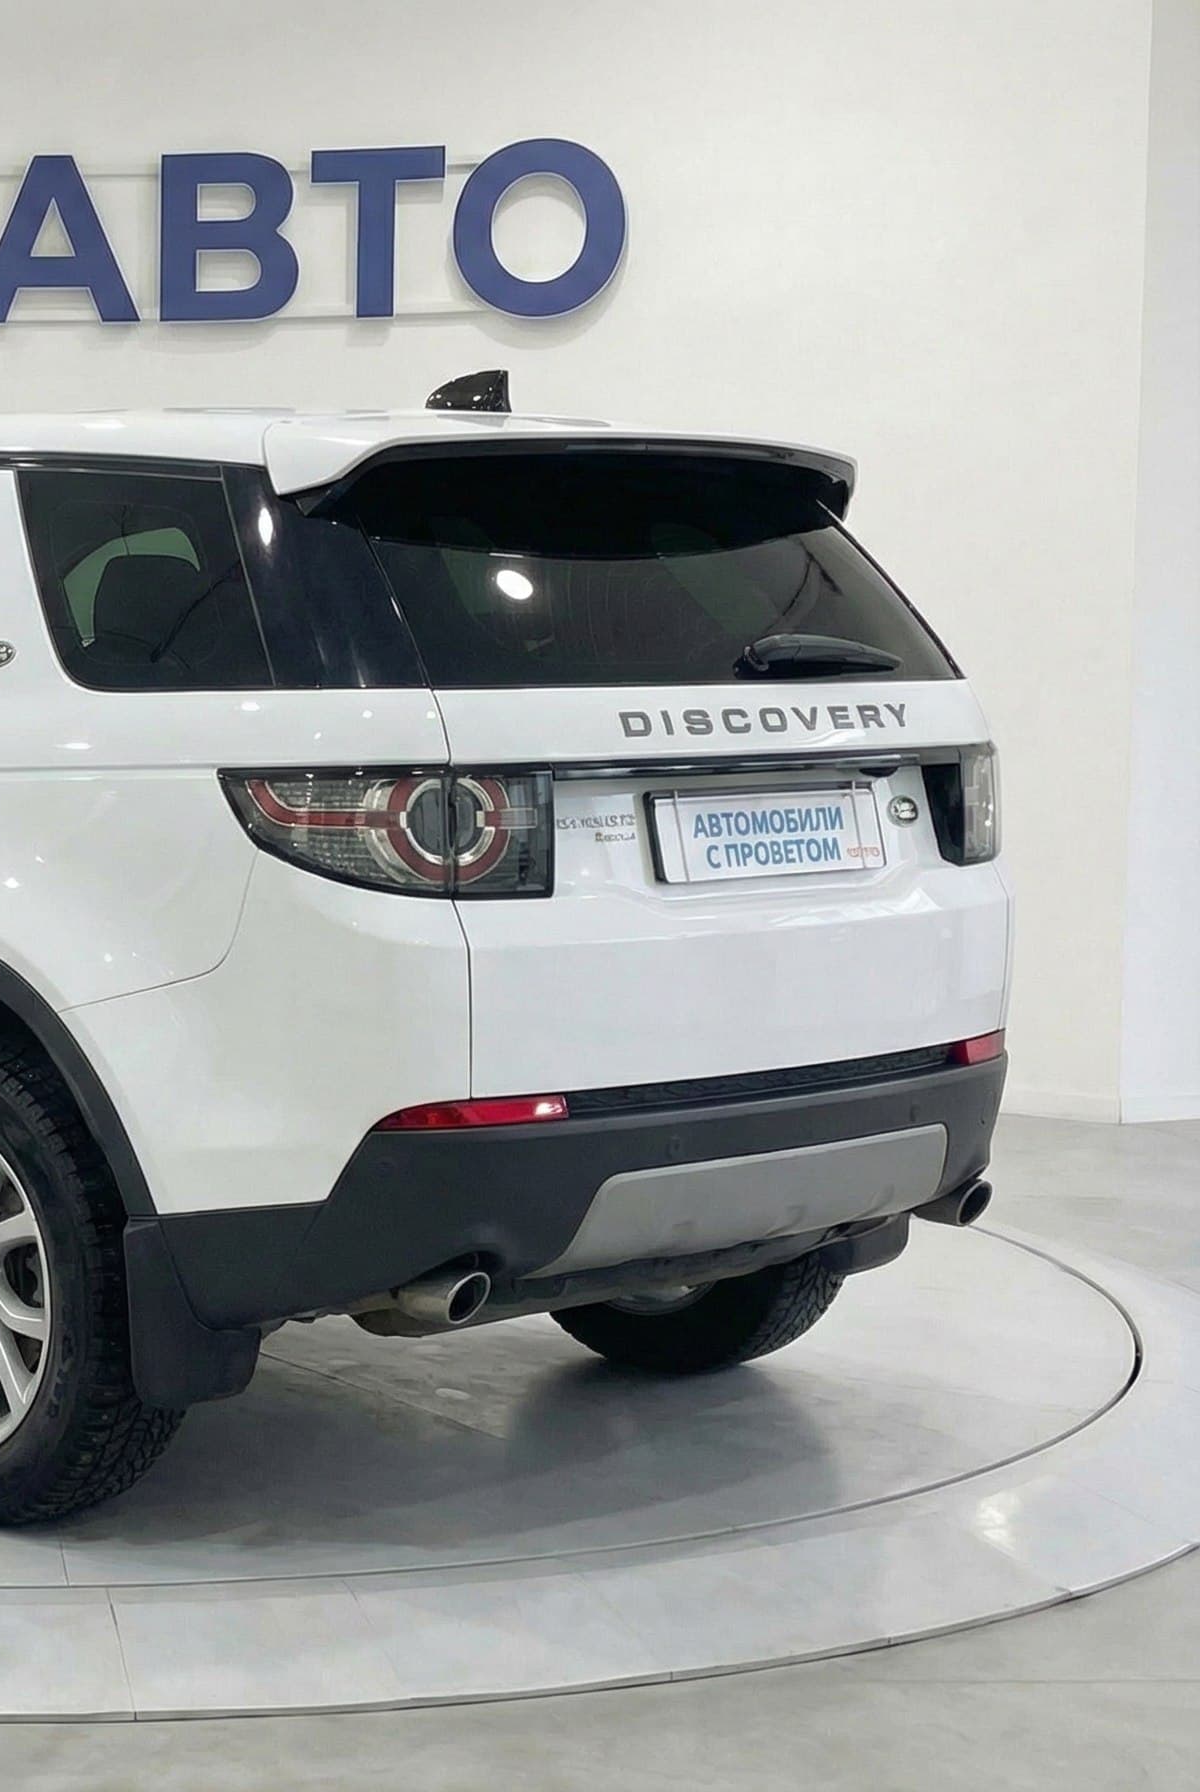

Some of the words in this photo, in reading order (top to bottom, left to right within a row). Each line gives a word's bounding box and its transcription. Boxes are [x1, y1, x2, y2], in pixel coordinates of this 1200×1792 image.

[618, 703, 906, 738] DISCOVERY
[693, 806, 844, 839] АВТОМОБИЛИ
[706, 845, 721, 869] С
[726, 837, 842, 868] ПРОВЕТОМ
